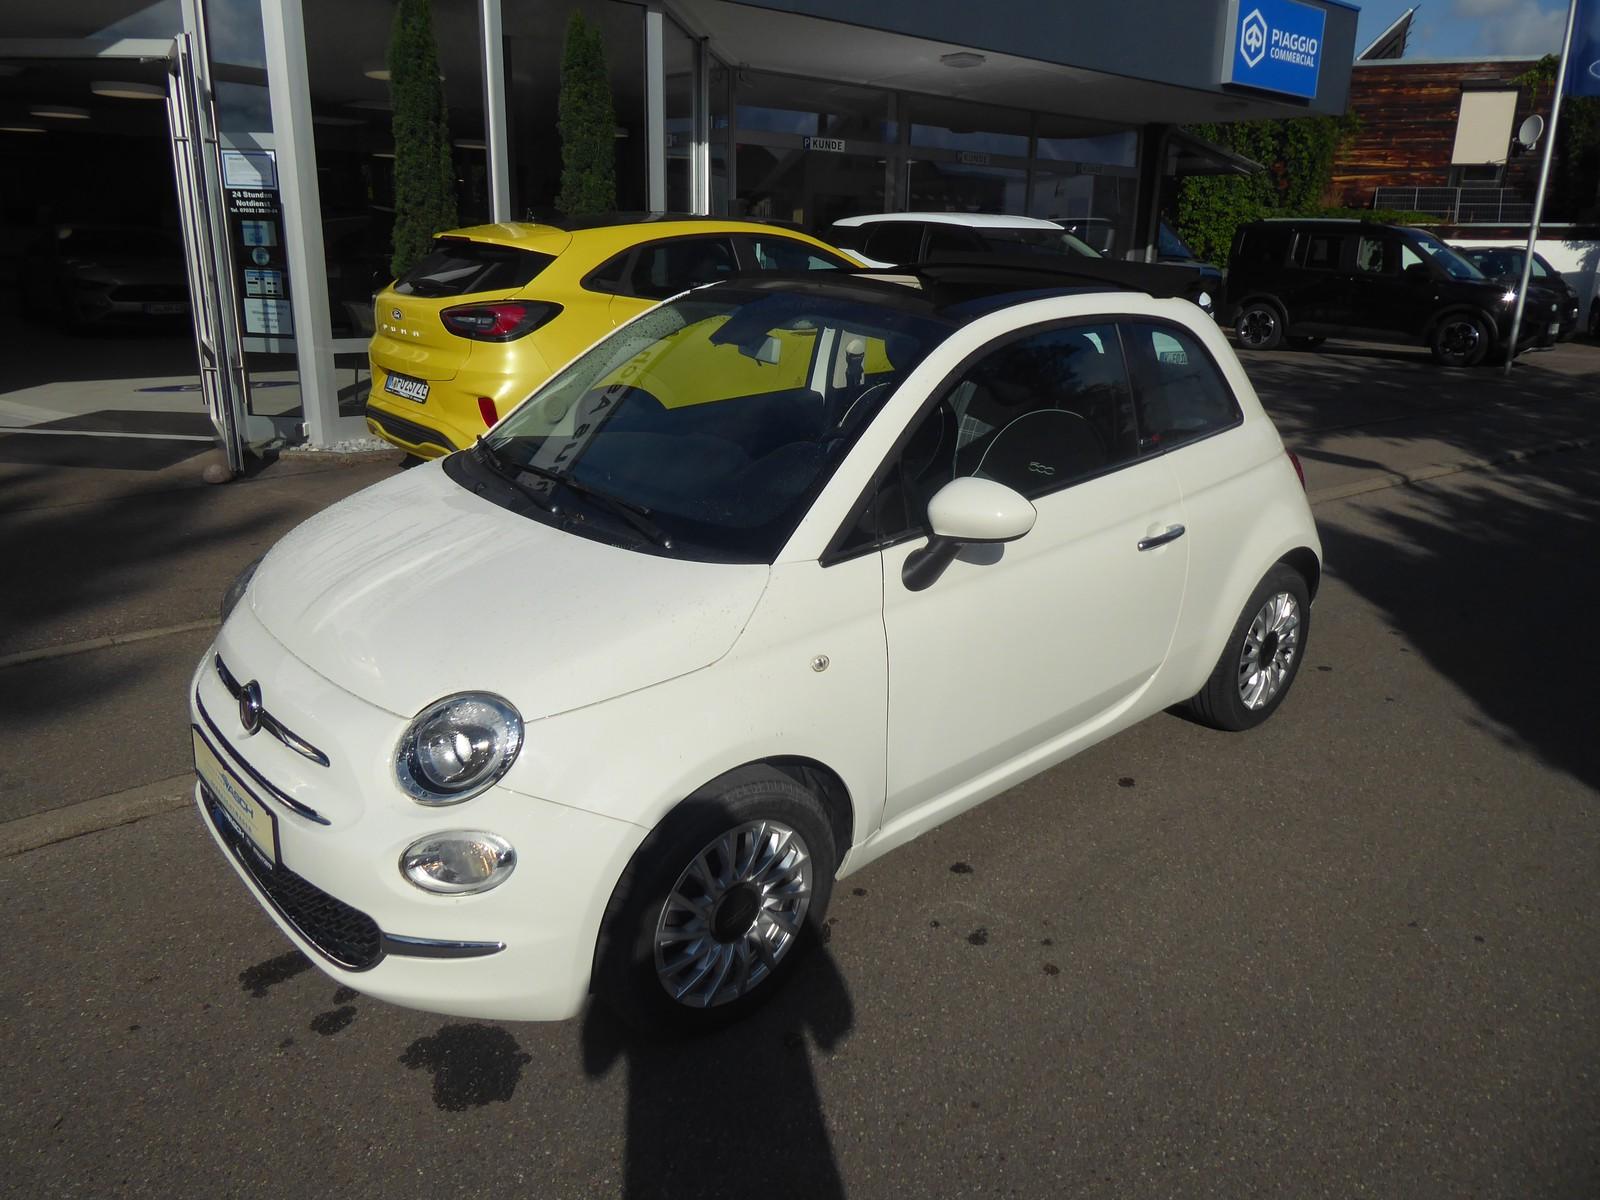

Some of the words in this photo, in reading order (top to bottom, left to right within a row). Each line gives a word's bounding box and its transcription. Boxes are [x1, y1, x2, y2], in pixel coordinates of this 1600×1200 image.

[1271, 28, 1318, 55] PIAGGIO
[1270, 46, 1315, 67] COMMERCIAL
[812, 139, 844, 151] KUNDE
[383, 323, 420, 337] PUMA
[1028, 461, 1056, 475] 500
